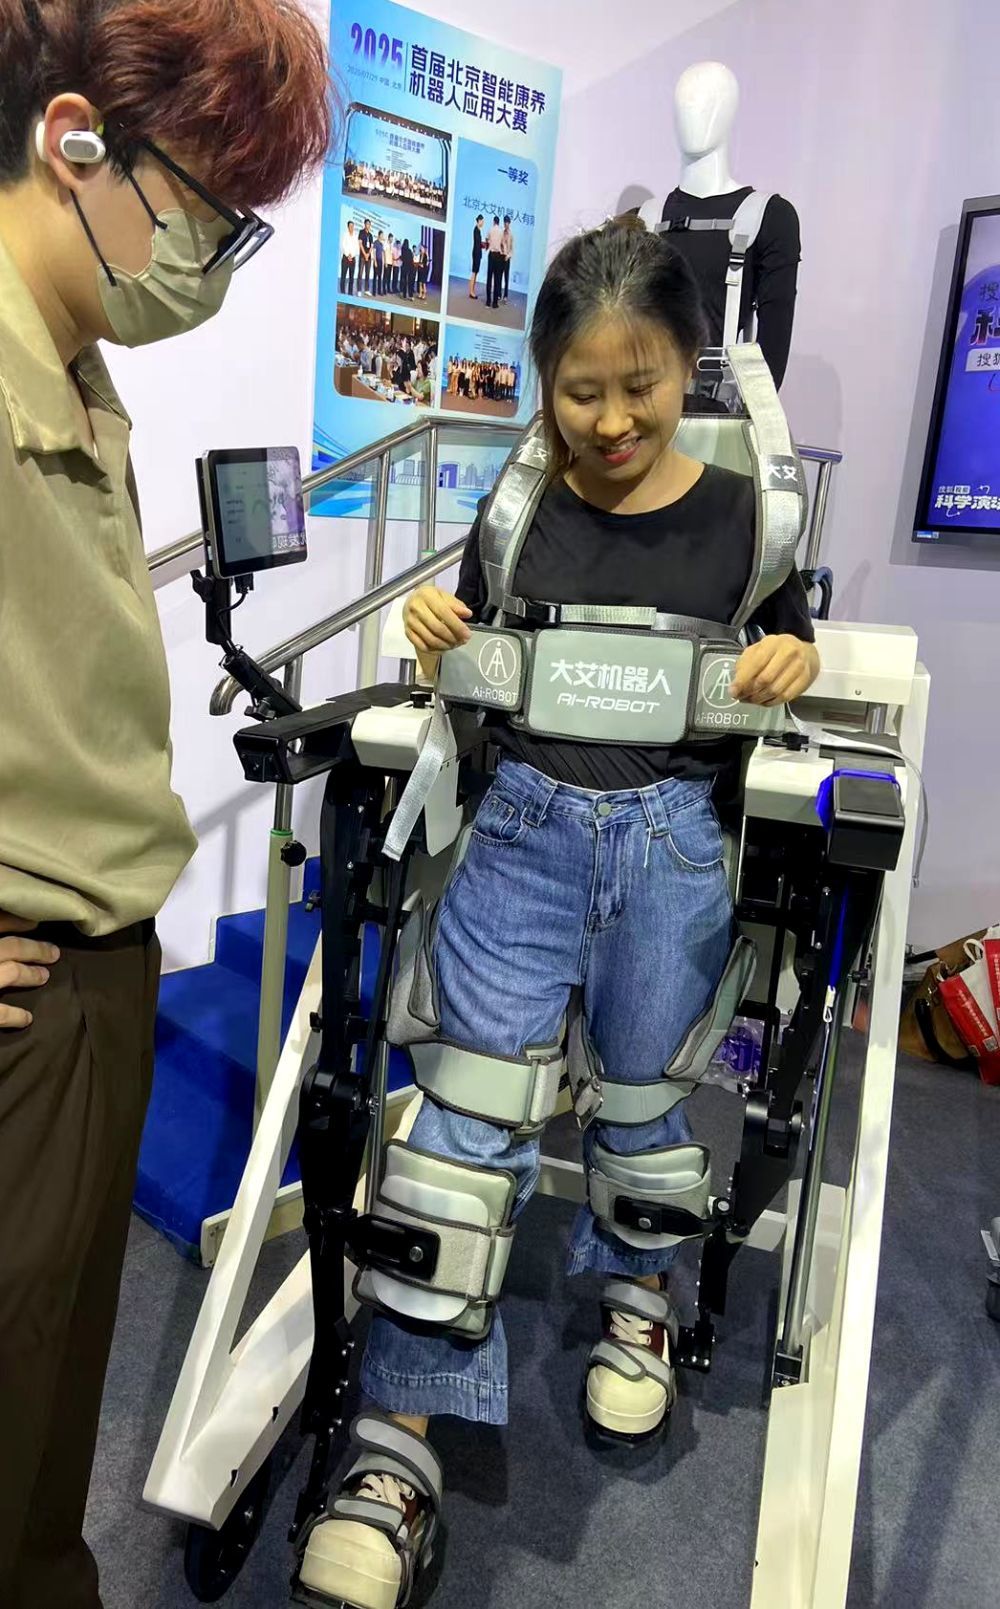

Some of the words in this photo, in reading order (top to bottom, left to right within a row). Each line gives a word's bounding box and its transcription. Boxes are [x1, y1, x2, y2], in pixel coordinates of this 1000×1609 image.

[351, 23, 403, 69] 2025
[409, 70, 528, 135] 机器人应用大赛
[411, 44, 545, 115] 首届北京智能康养
[497, 166, 529, 186] 一等奖
[550, 659, 672, 696] 大艾机器人
